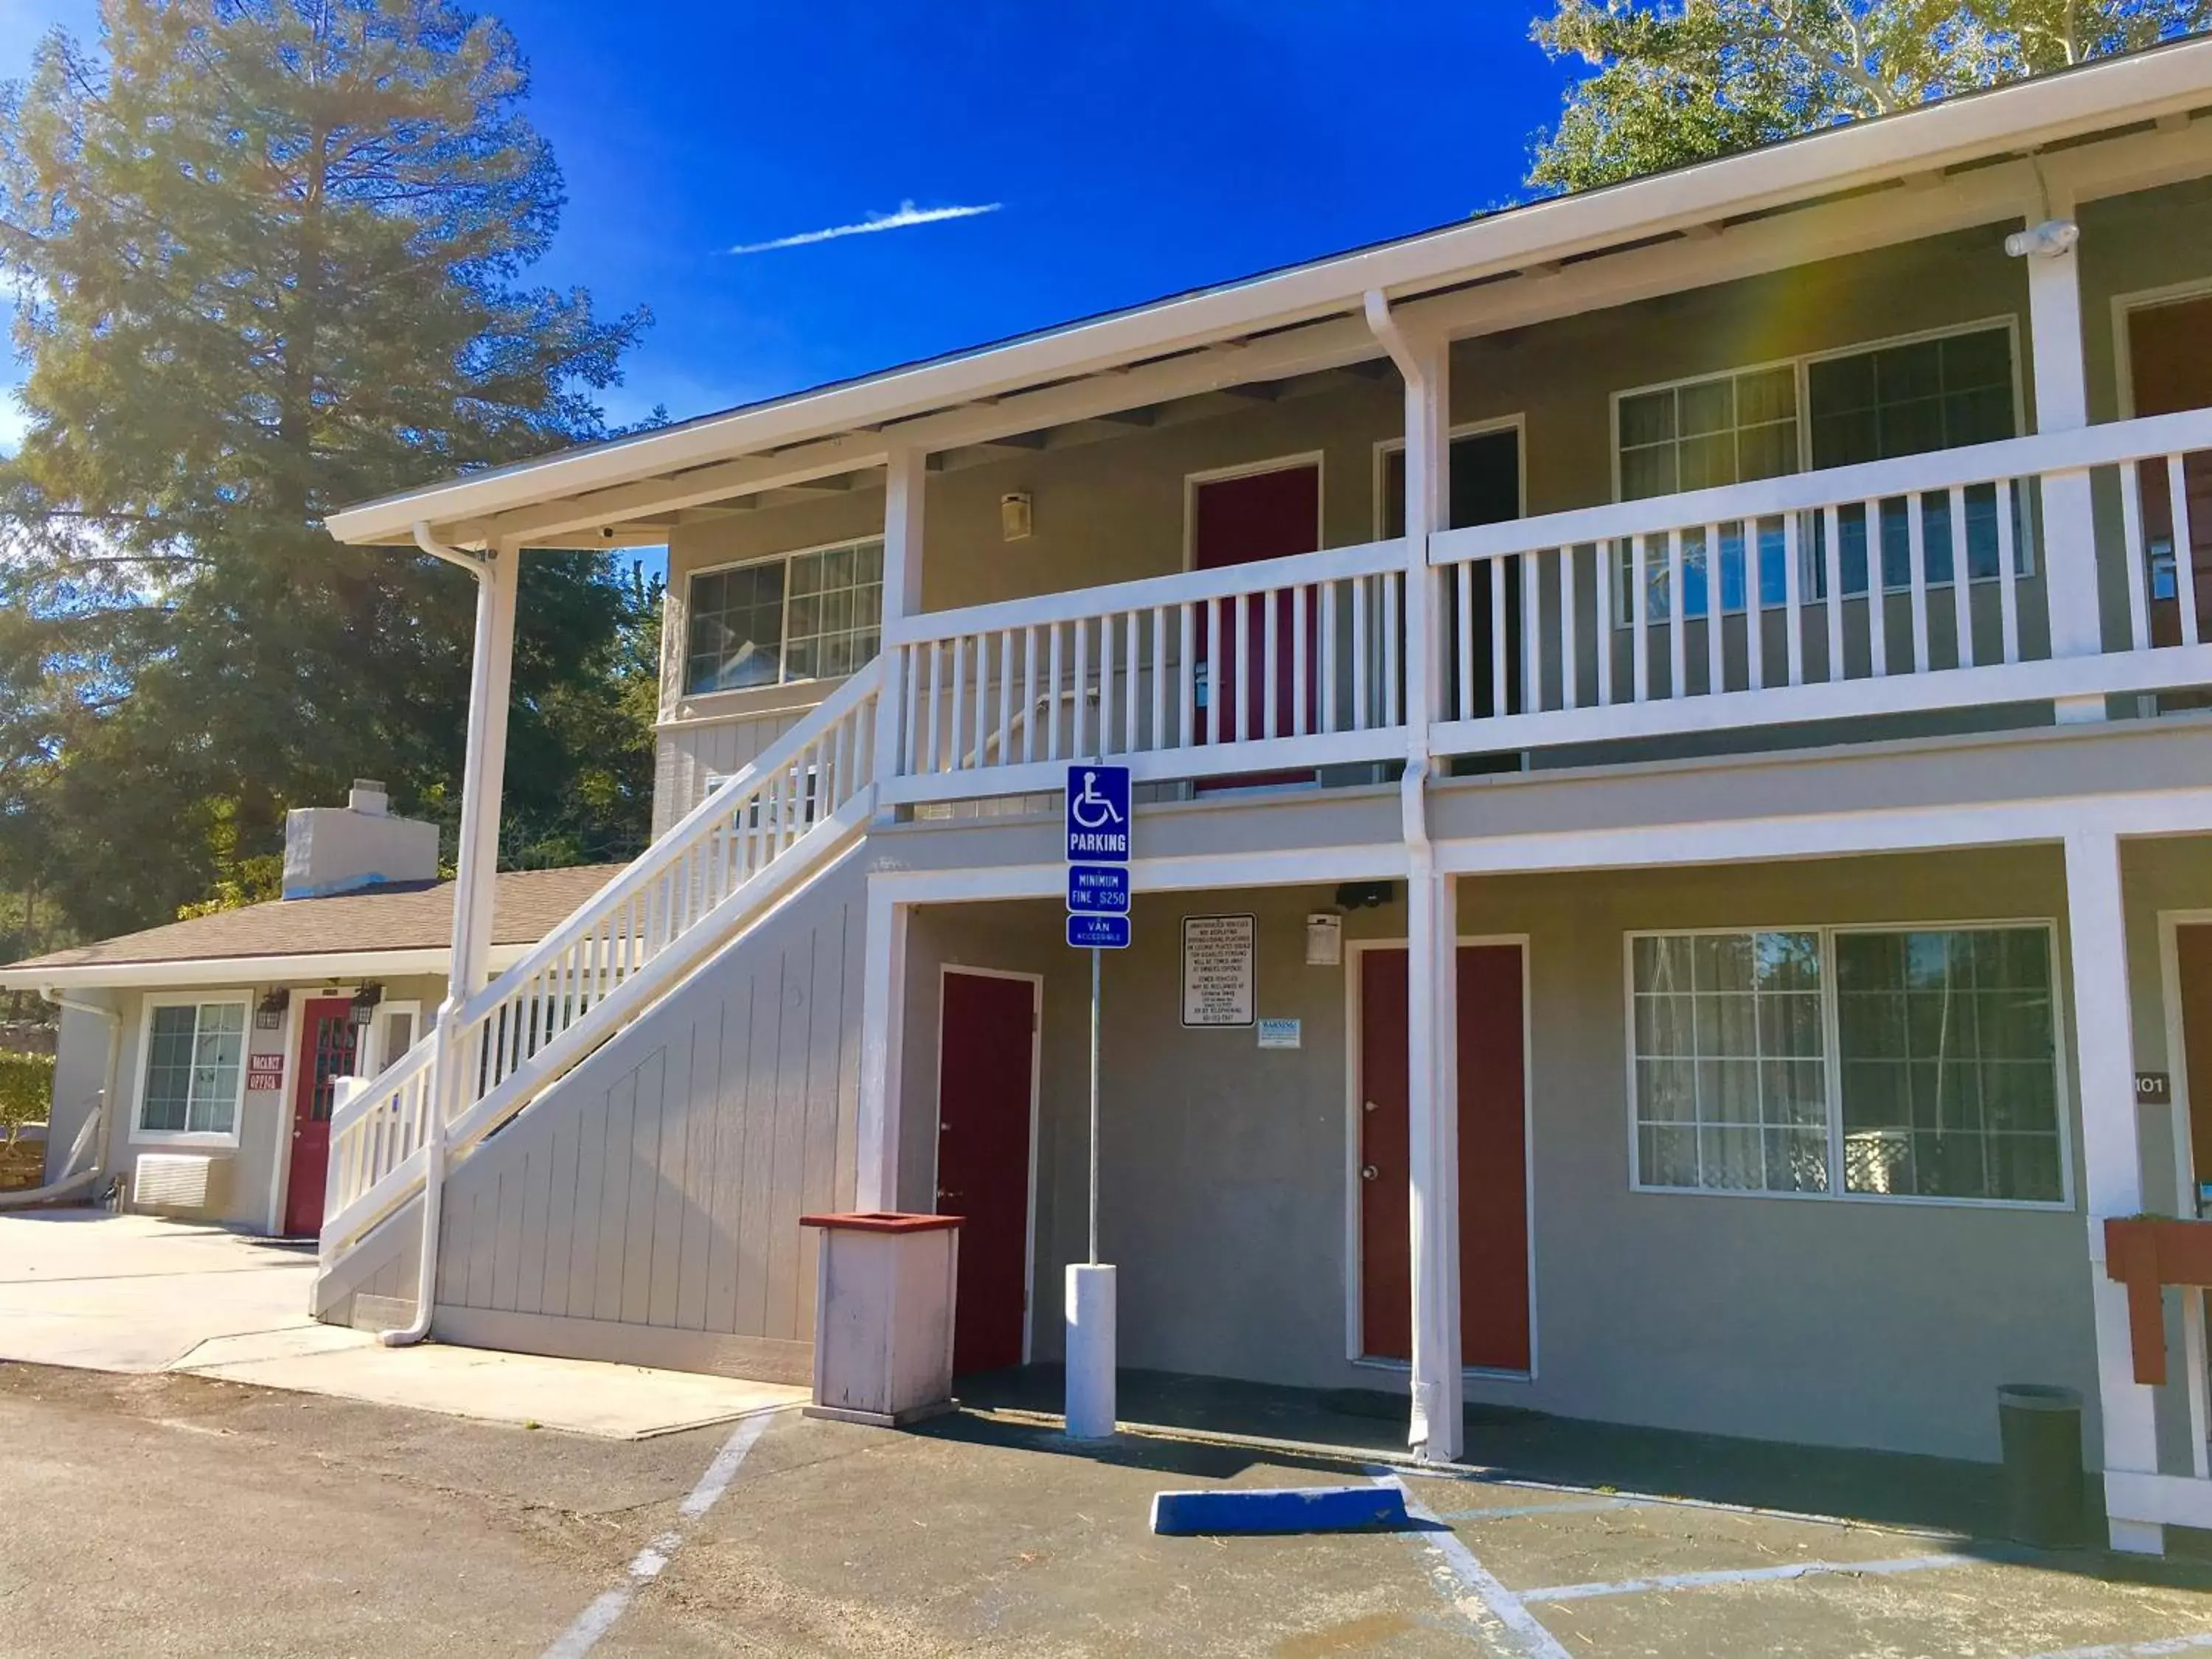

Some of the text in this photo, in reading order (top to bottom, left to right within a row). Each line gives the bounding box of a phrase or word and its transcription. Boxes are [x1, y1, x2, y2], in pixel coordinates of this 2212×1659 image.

[1071, 833, 1127, 852] PARKING
[1079, 874, 1119, 888] MINIMUM
[1072, 890, 1125, 905] FINE $250
[1088, 922, 1110, 932] VAN
